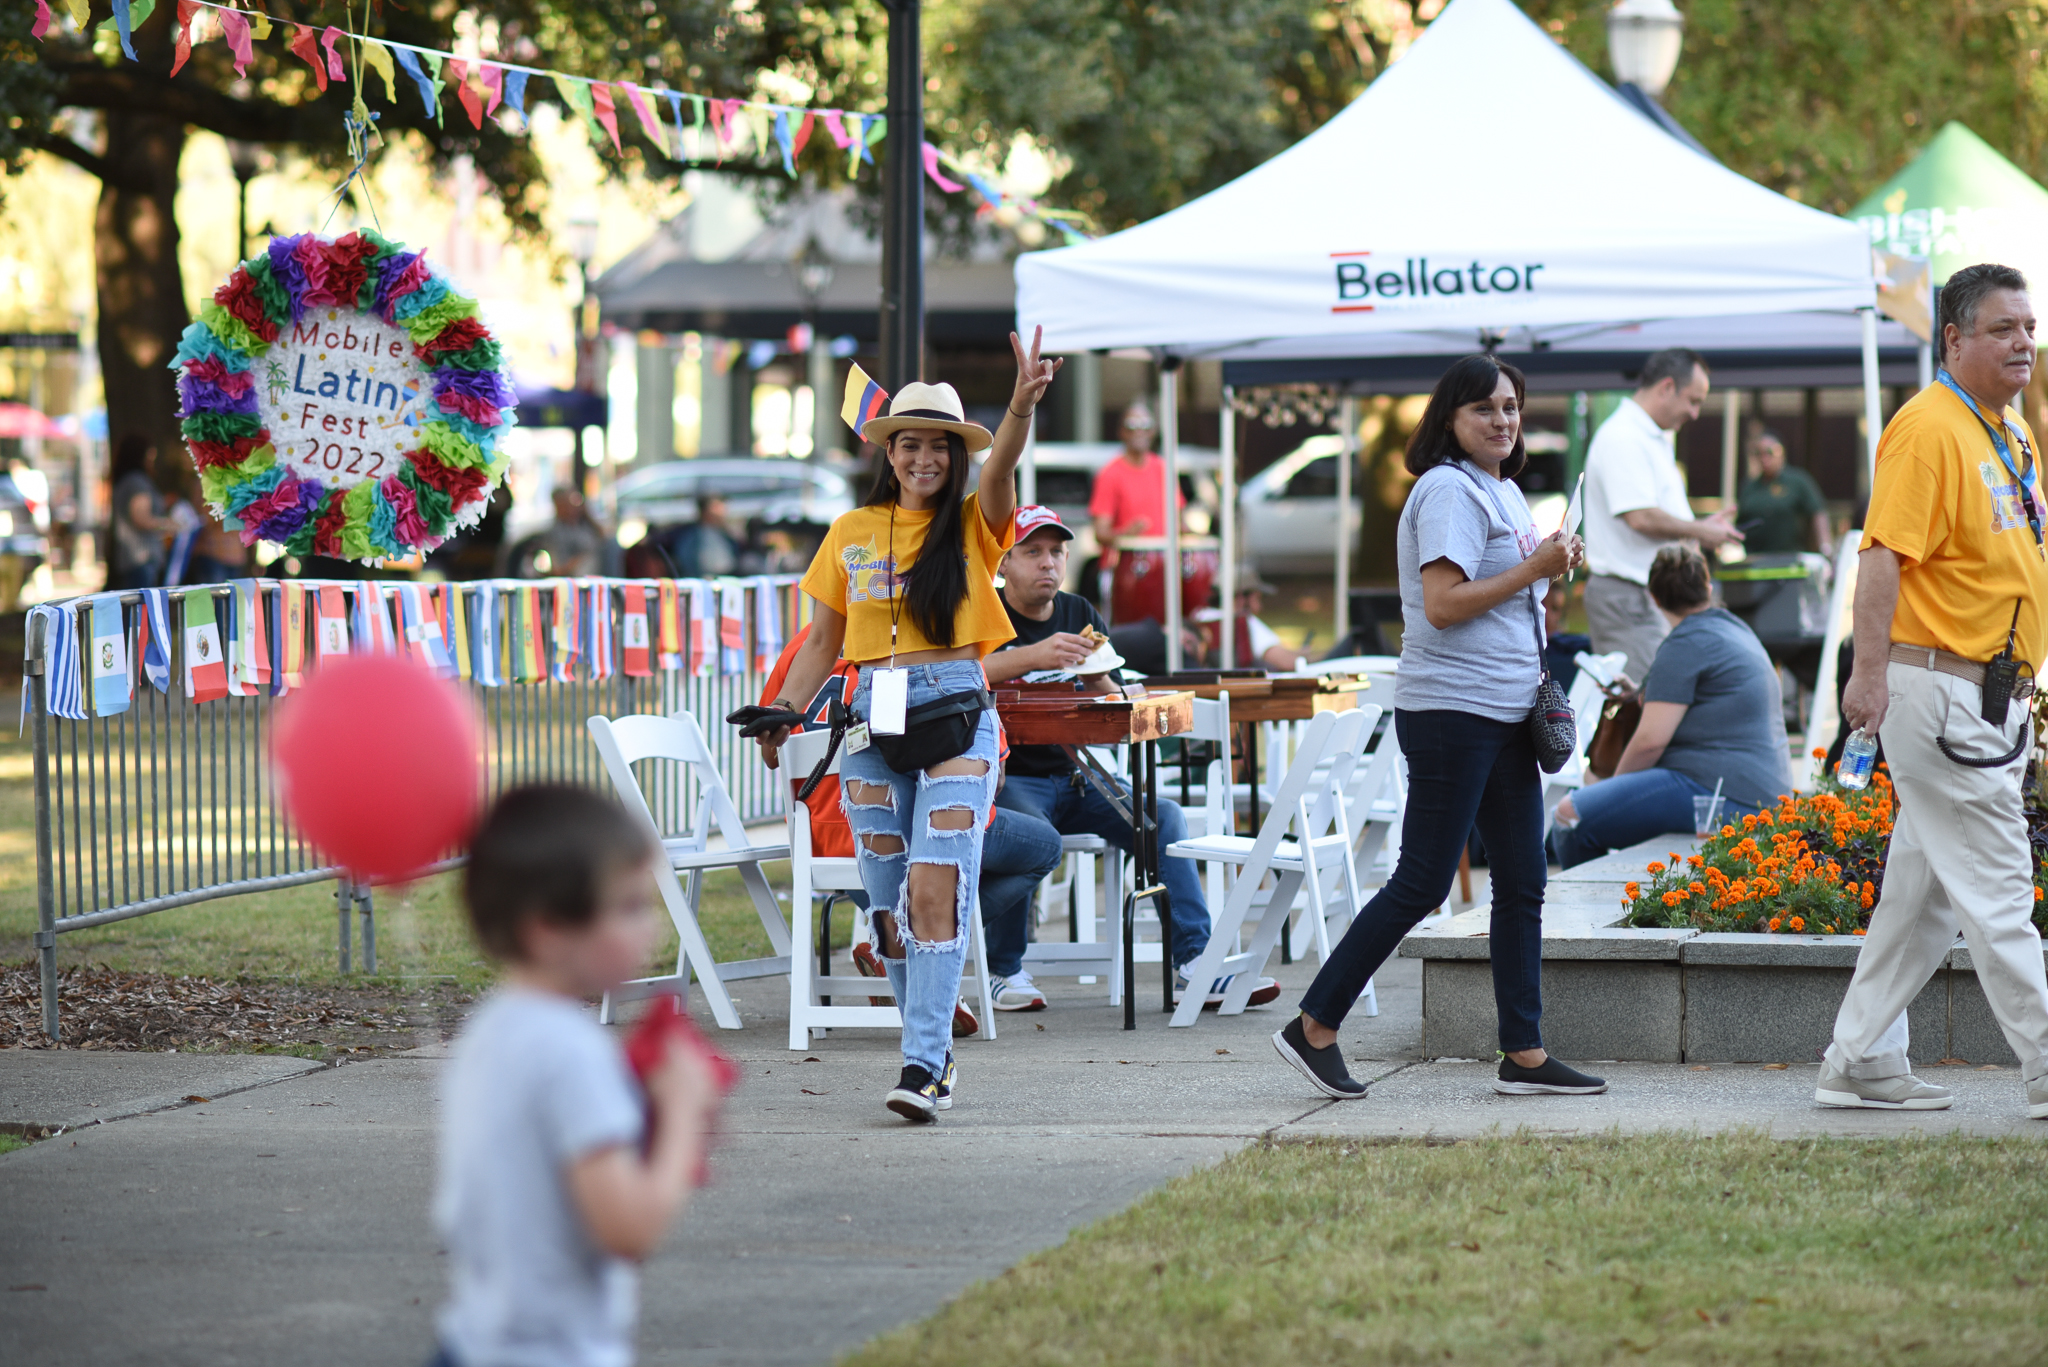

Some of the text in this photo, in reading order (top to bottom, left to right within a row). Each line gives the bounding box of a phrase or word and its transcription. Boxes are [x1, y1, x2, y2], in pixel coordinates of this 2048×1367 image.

[1337, 257, 1544, 299] Bellator
[292, 322, 404, 357] Mobile
[293, 353, 399, 411] Latin
[301, 403, 370, 439] Fest
[301, 438, 386, 479] 2022
